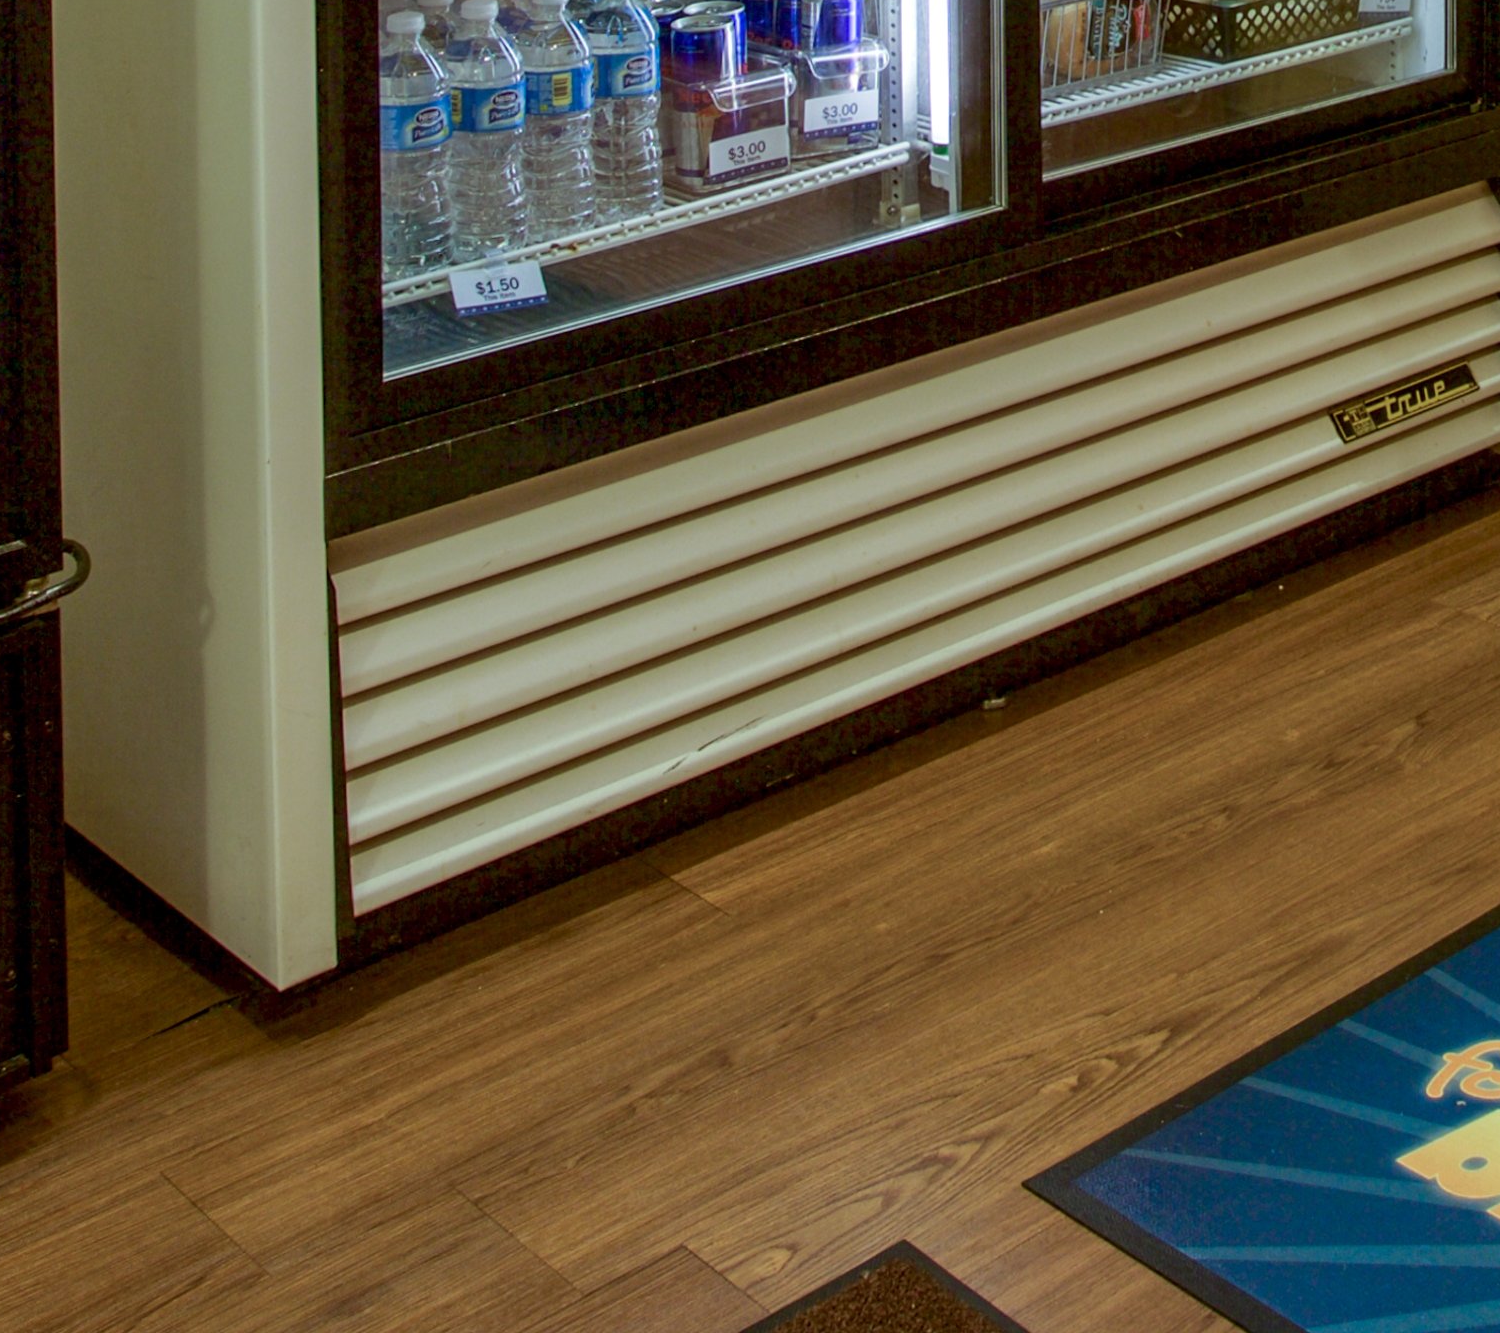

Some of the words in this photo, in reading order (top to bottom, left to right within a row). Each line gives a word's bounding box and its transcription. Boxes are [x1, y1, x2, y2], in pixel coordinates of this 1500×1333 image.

[822, 101, 859, 119] $3.00
[727, 140, 767, 160] $3.00
[474, 276, 521, 295] $1.50
